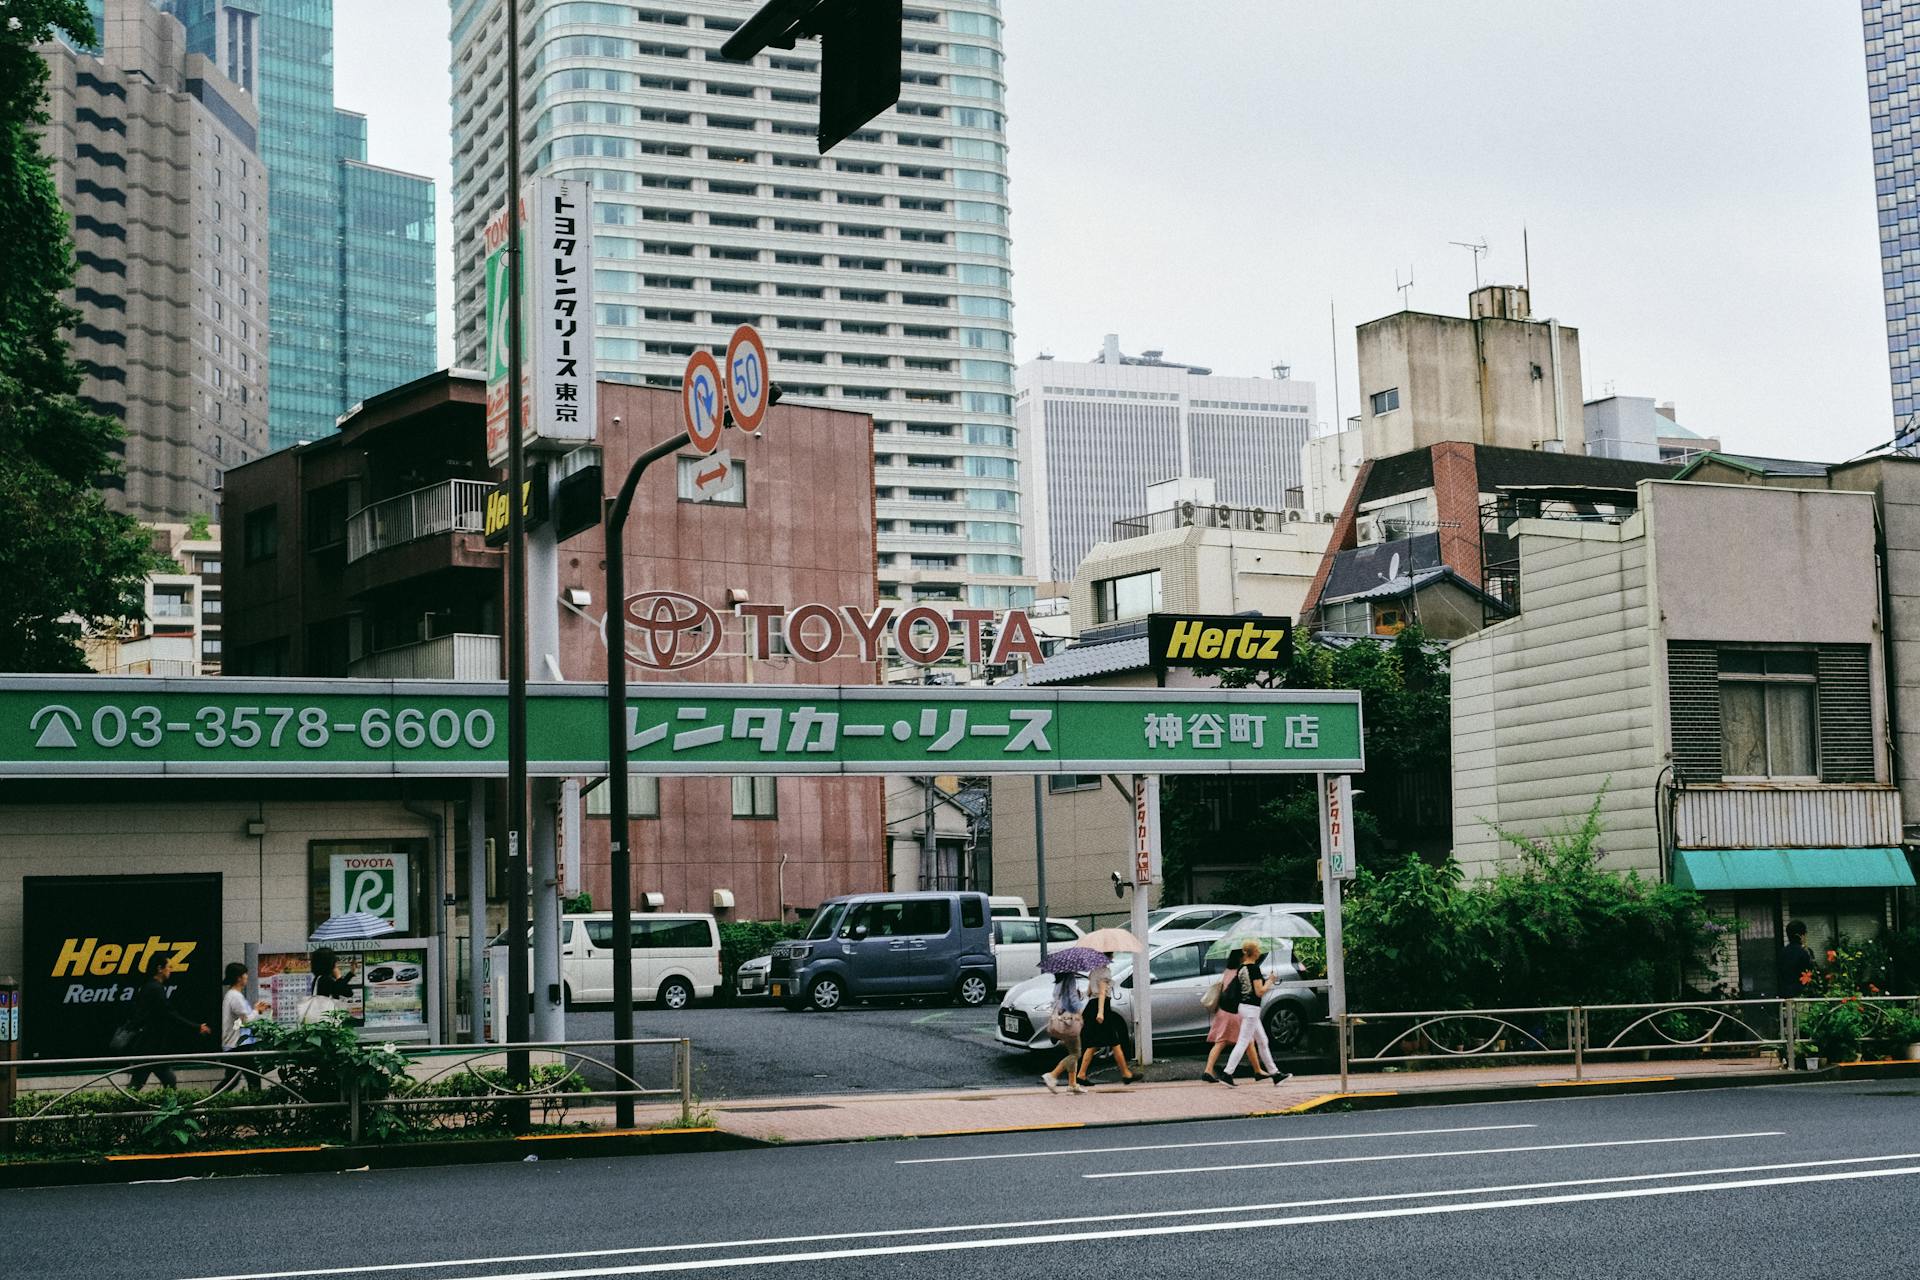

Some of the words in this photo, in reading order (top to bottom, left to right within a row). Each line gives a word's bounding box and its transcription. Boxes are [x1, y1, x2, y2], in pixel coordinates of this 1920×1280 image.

[733, 353, 759, 404] 50
[735, 604, 1046, 665] TOYOTA
[1166, 620, 1285, 660] Hertz
[91, 705, 496, 748] 03-3578-6600
[1329, 782, 1340, 847] レンタカー
[344, 858, 394, 868] TOYOTA
[51, 936, 198, 977] Hertz
[306, 940, 381, 951] INFORMATION
[63, 984, 118, 1003] Rent
[120, 987, 135, 1001] a
